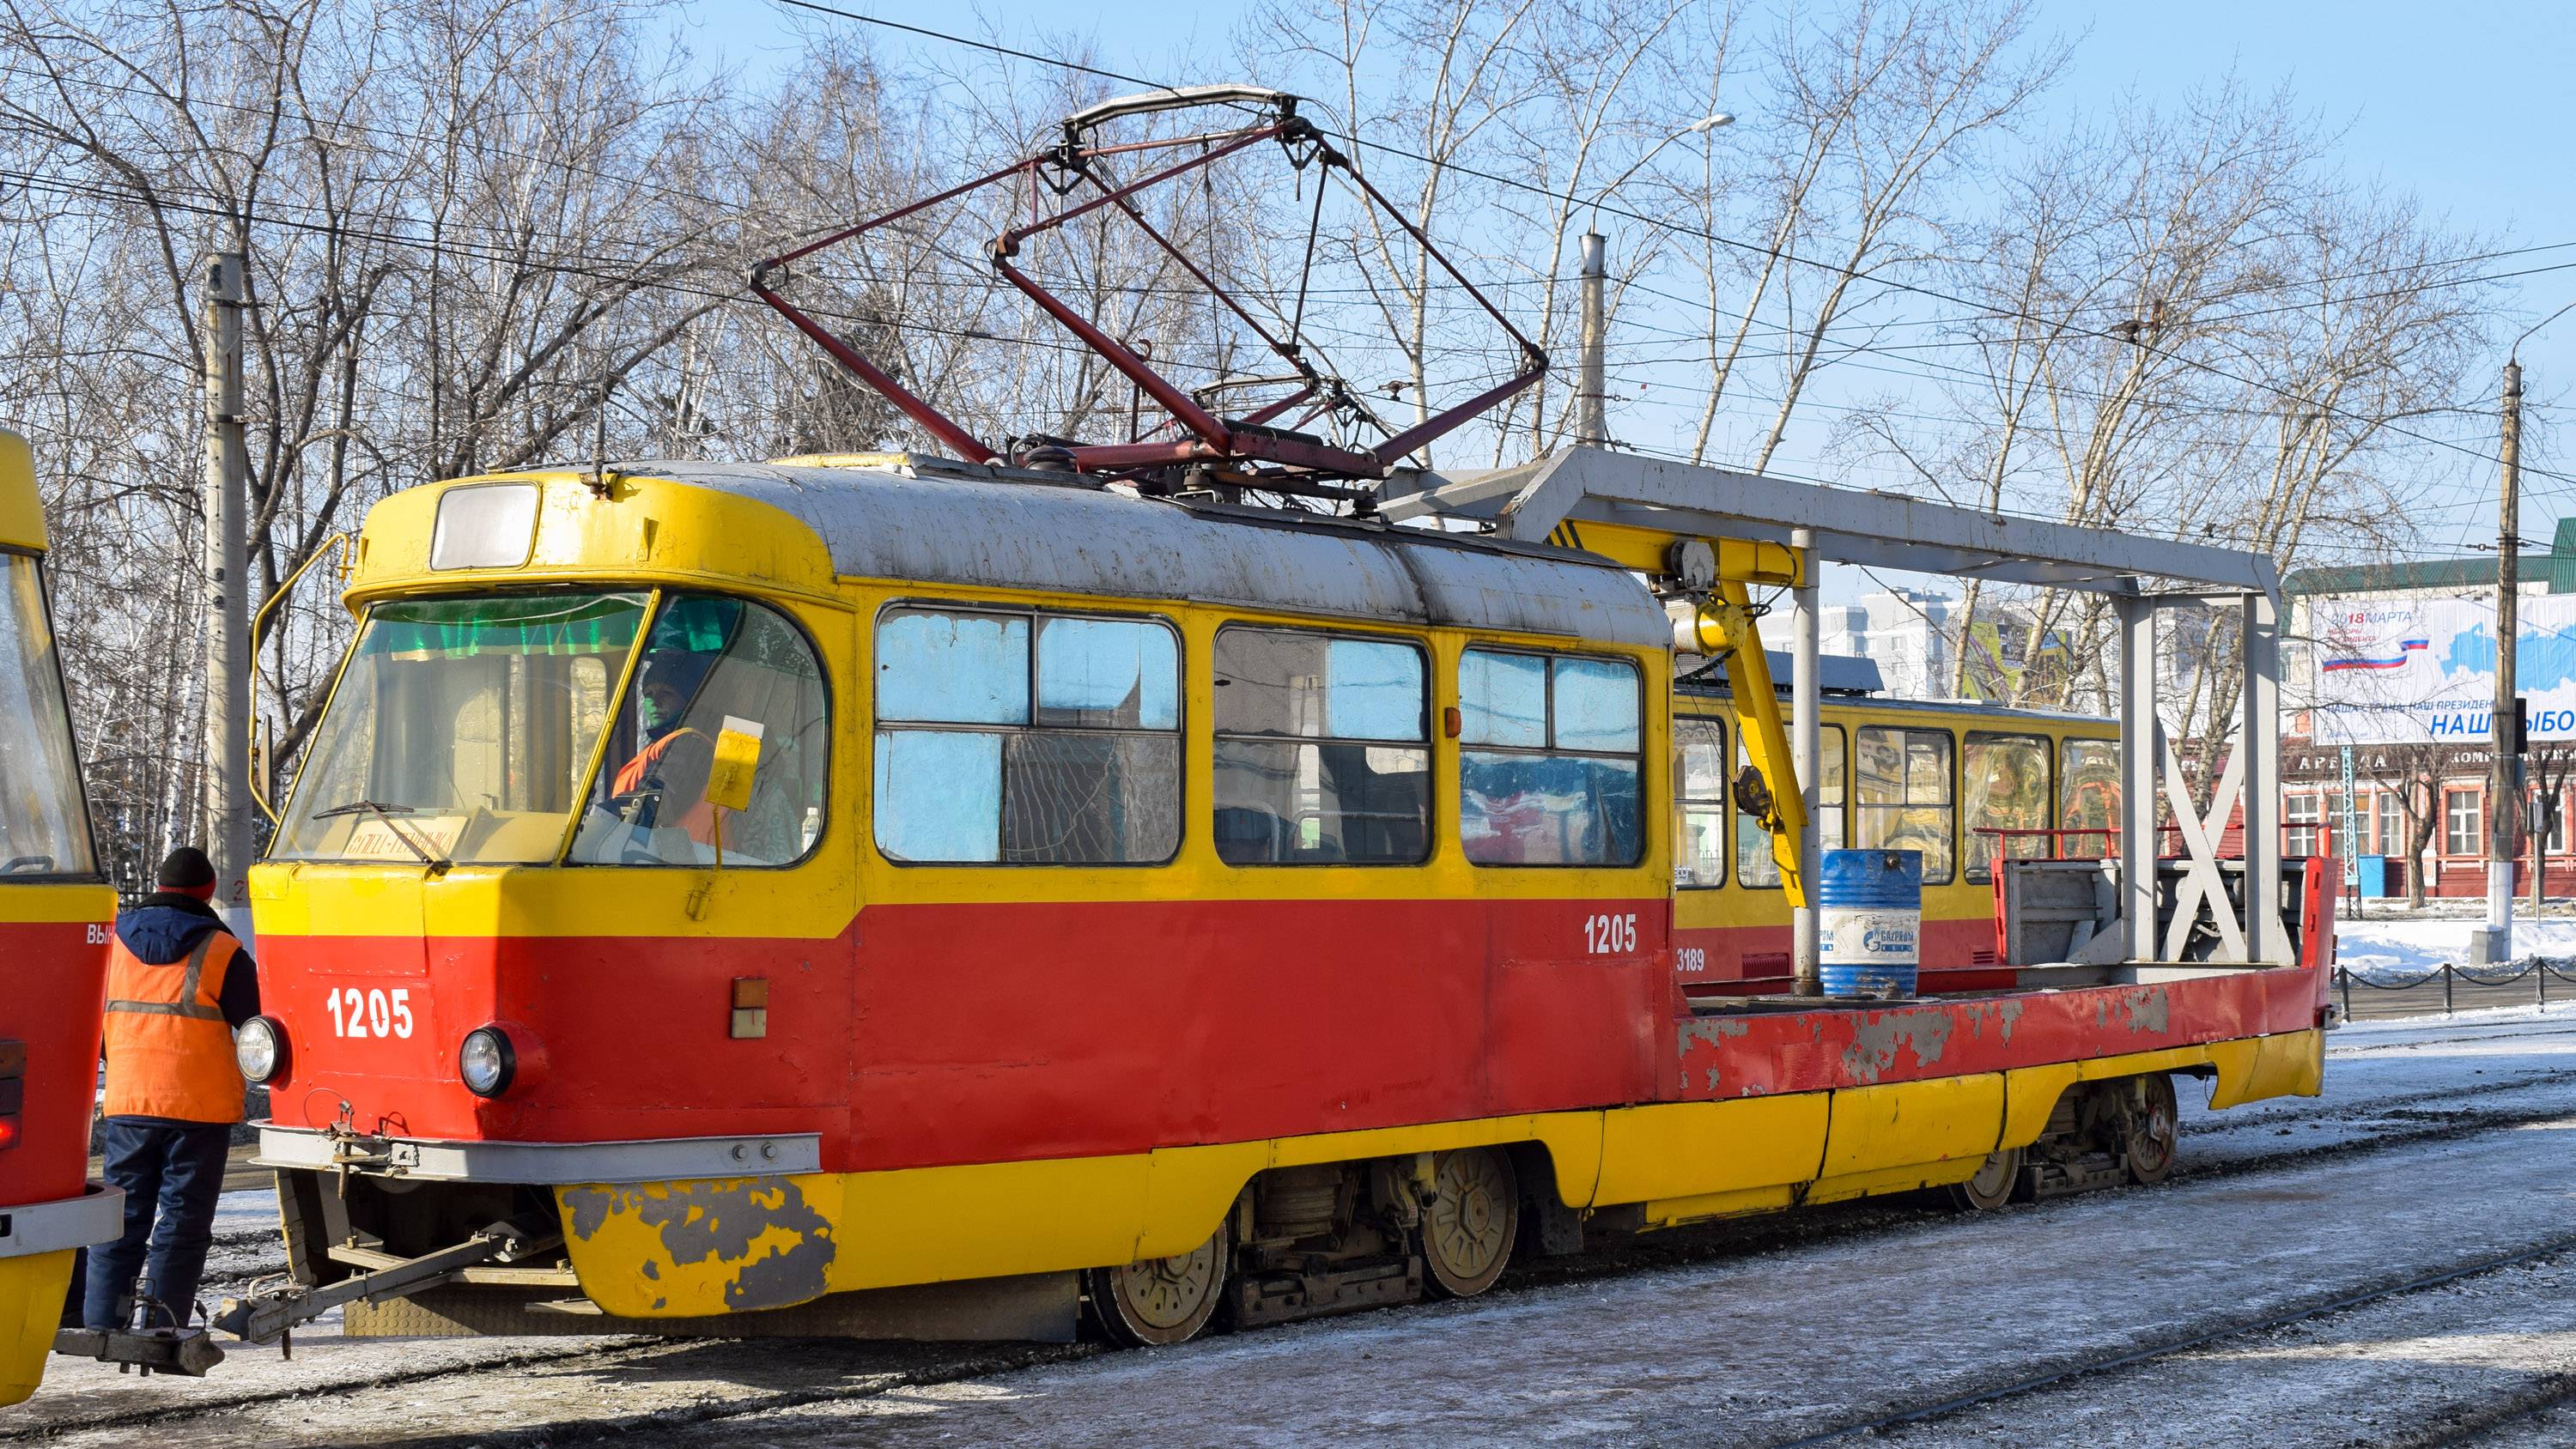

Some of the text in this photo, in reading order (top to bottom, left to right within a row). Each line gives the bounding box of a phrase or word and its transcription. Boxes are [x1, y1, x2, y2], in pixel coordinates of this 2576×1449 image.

[2298, 755, 2387, 770] АРЕДА
[1584, 913, 1637, 954] 1205
[1676, 948, 1704, 972] 3189
[326, 987, 413, 1039] 1205
